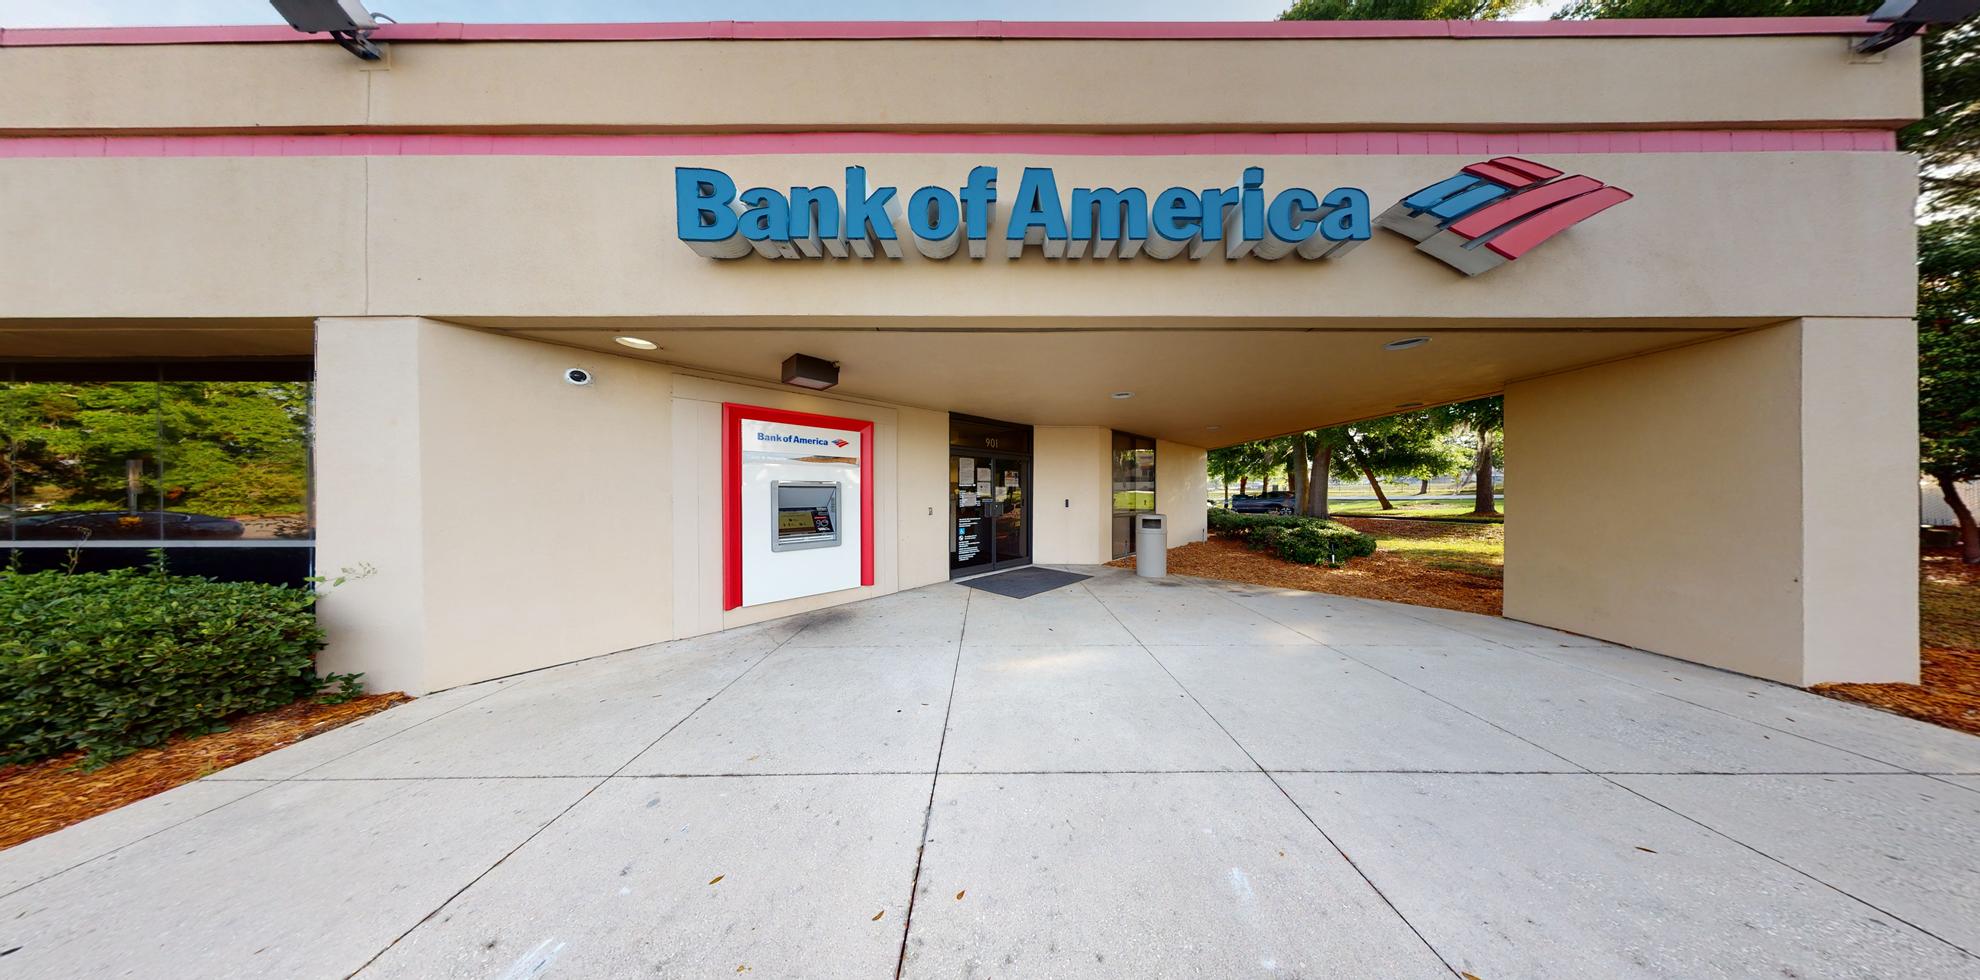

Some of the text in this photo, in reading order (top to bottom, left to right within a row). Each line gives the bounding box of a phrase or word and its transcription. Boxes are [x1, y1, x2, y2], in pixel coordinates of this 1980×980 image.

[675, 166, 1372, 243] Bank of America
[757, 432, 782, 442] Bank
[793, 435, 829, 446] America
[985, 438, 999, 448] 901
